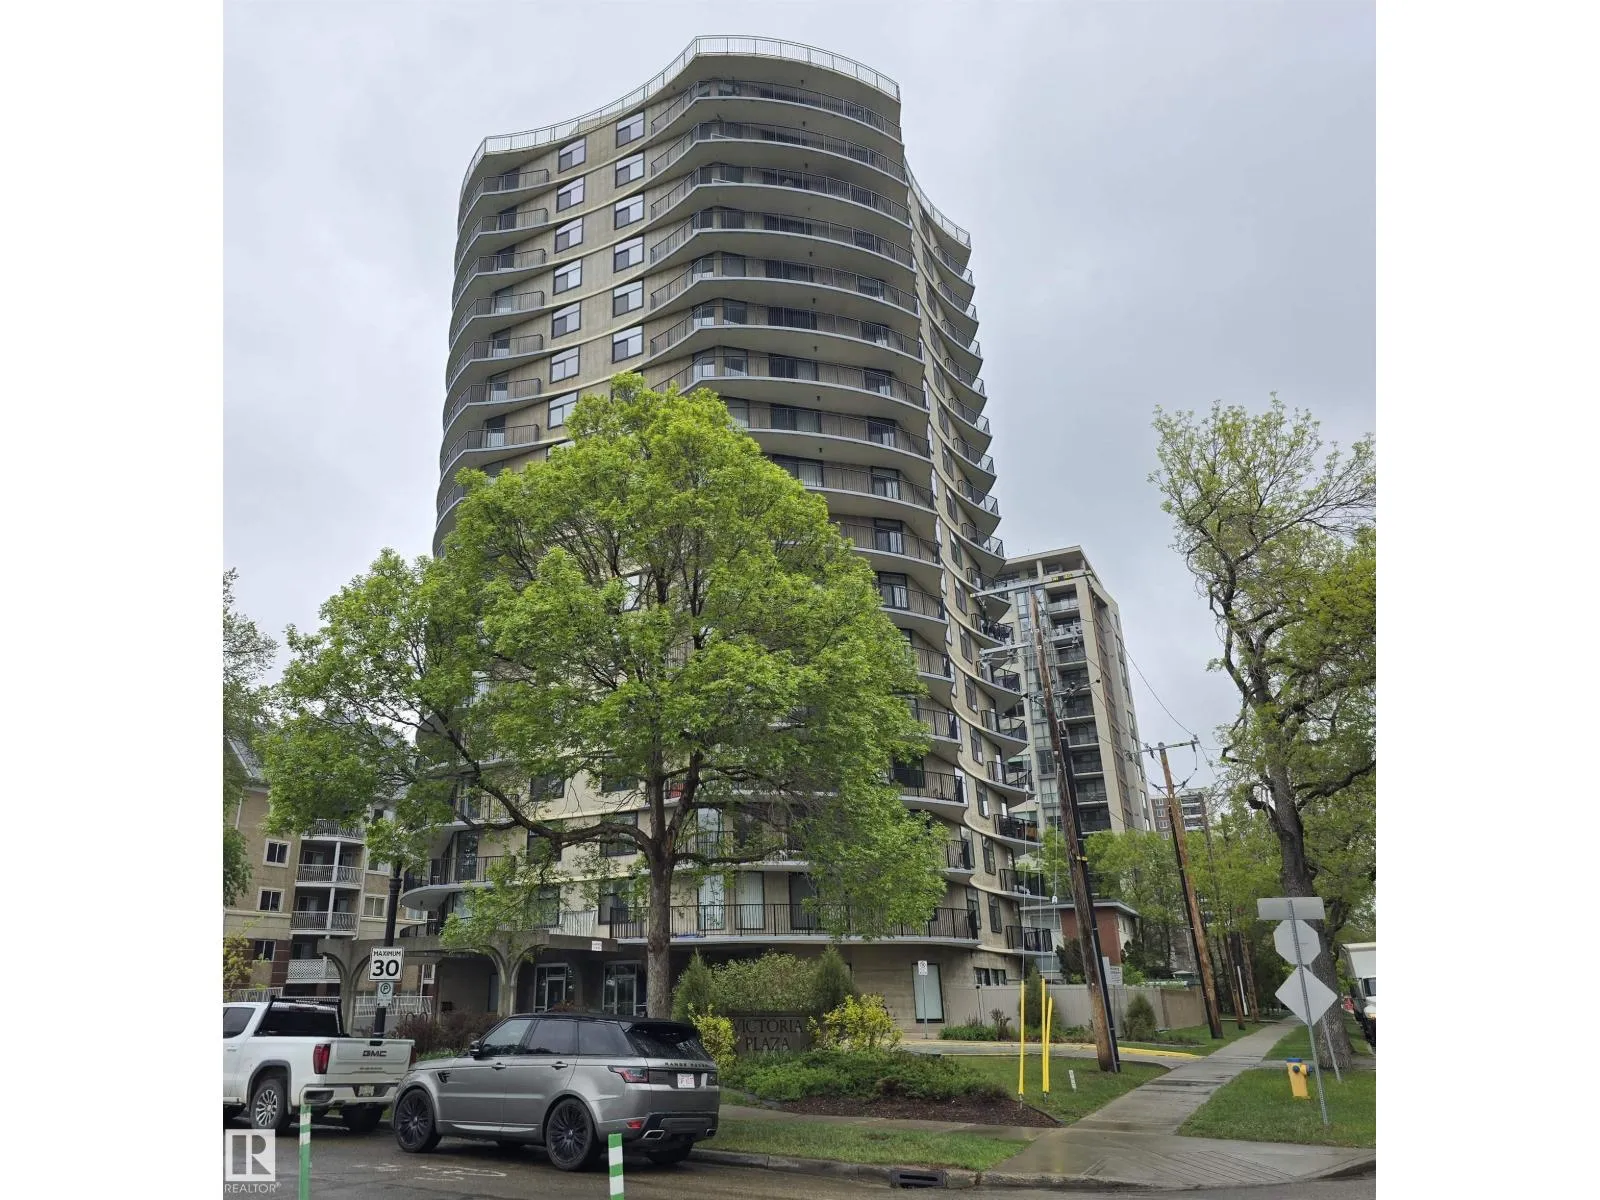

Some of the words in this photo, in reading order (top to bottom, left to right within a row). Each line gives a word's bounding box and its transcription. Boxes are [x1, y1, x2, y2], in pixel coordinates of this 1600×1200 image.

[372, 960, 399, 976] 30
[733, 1018, 804, 1033] VICTORIA
[745, 1036, 791, 1051] PLAZA
